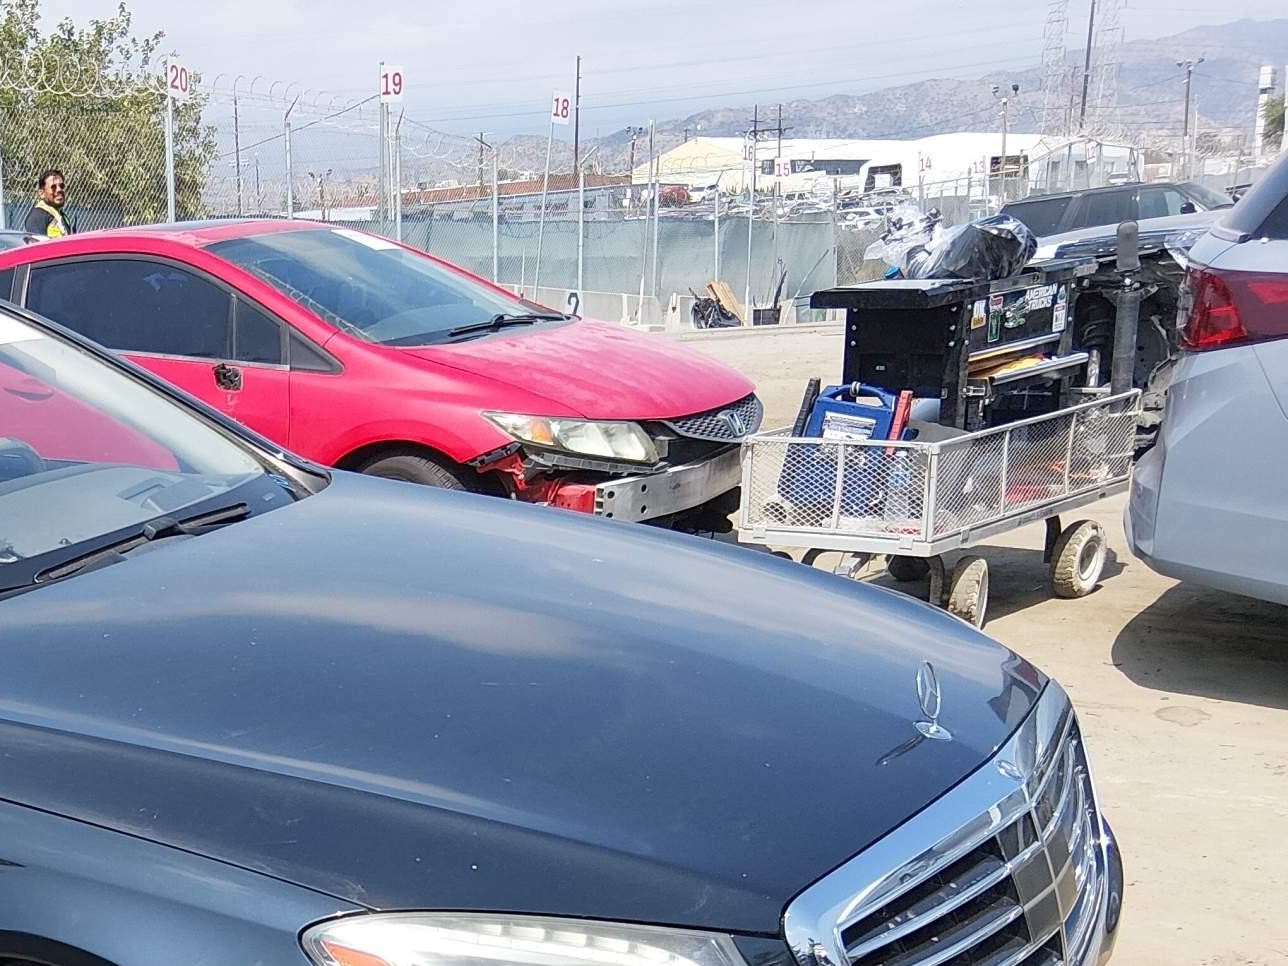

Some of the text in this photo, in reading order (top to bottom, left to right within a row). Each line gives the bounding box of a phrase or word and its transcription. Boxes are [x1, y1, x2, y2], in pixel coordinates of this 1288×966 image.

[169, 64, 188, 93] 20
[381, 72, 403, 95] 19
[552, 97, 570, 118] 18
[743, 145, 753, 161] 16
[775, 163, 790, 177] 15
[919, 155, 932, 172] 14
[1025, 283, 1058, 301] AMERICAN
[1028, 295, 1053, 311] TRUCKS
